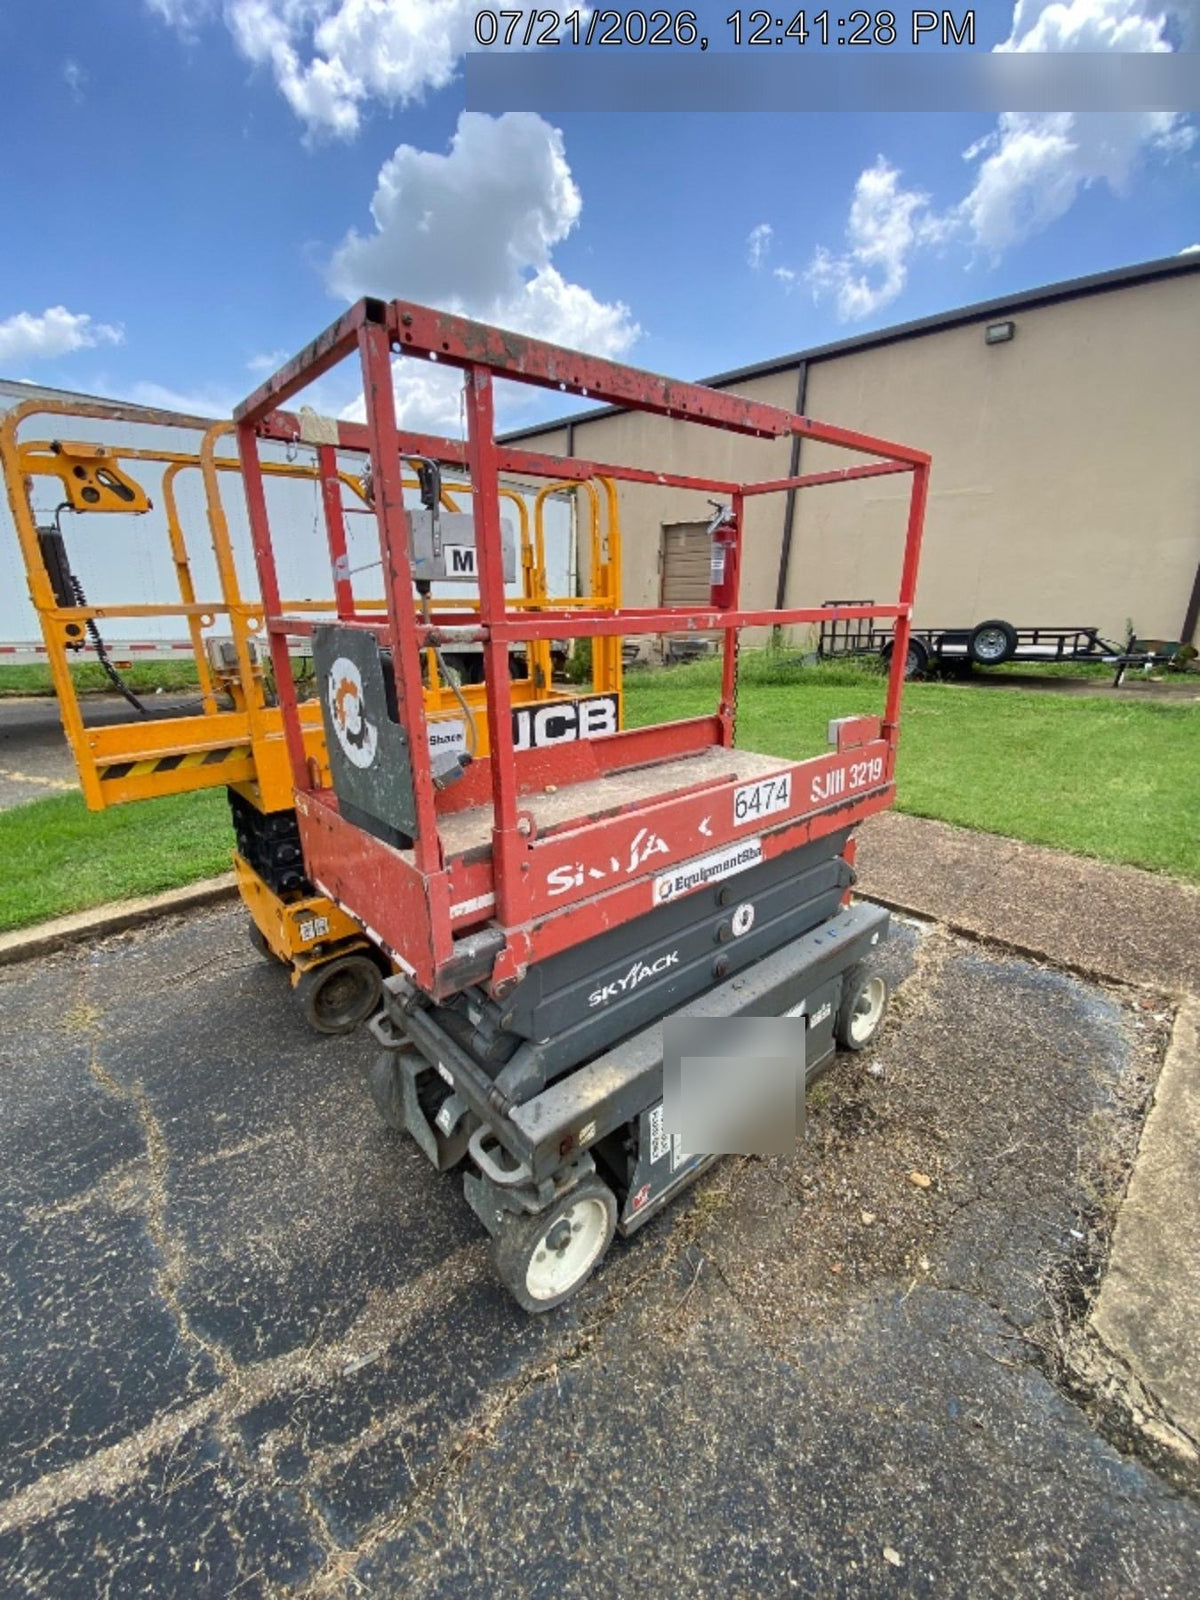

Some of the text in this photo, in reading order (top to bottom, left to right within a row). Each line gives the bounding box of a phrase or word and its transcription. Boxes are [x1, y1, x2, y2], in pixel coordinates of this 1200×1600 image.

[453, 550, 473, 571] M
[513, 697, 617, 753] JCB
[849, 757, 883, 789] 3219
[735, 778, 788, 819] 6474
[675, 847, 762, 891] EquipmentSha
[588, 950, 679, 1007] SKYJACK
